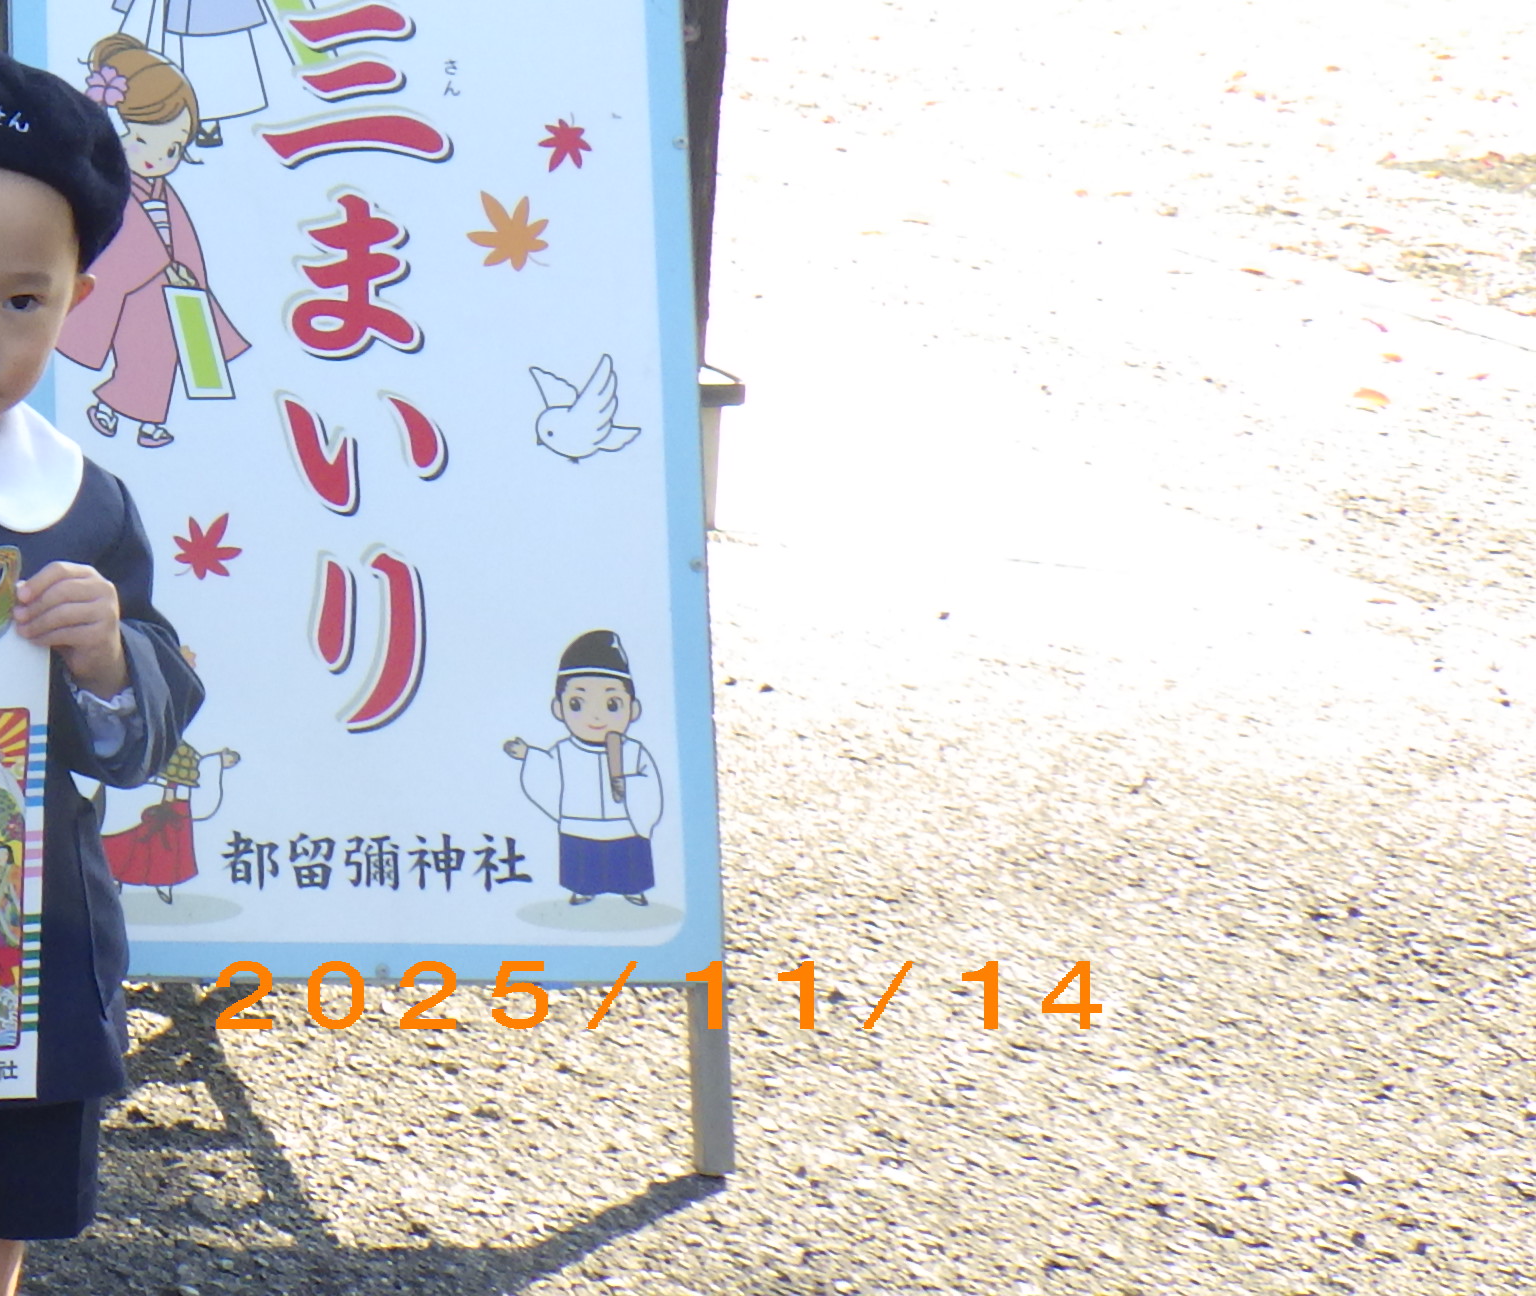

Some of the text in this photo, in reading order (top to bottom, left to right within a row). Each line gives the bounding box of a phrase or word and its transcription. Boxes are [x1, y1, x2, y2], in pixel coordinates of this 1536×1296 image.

[442, 58, 461, 96] さん
[220, 828, 534, 895] 都留彌神社
